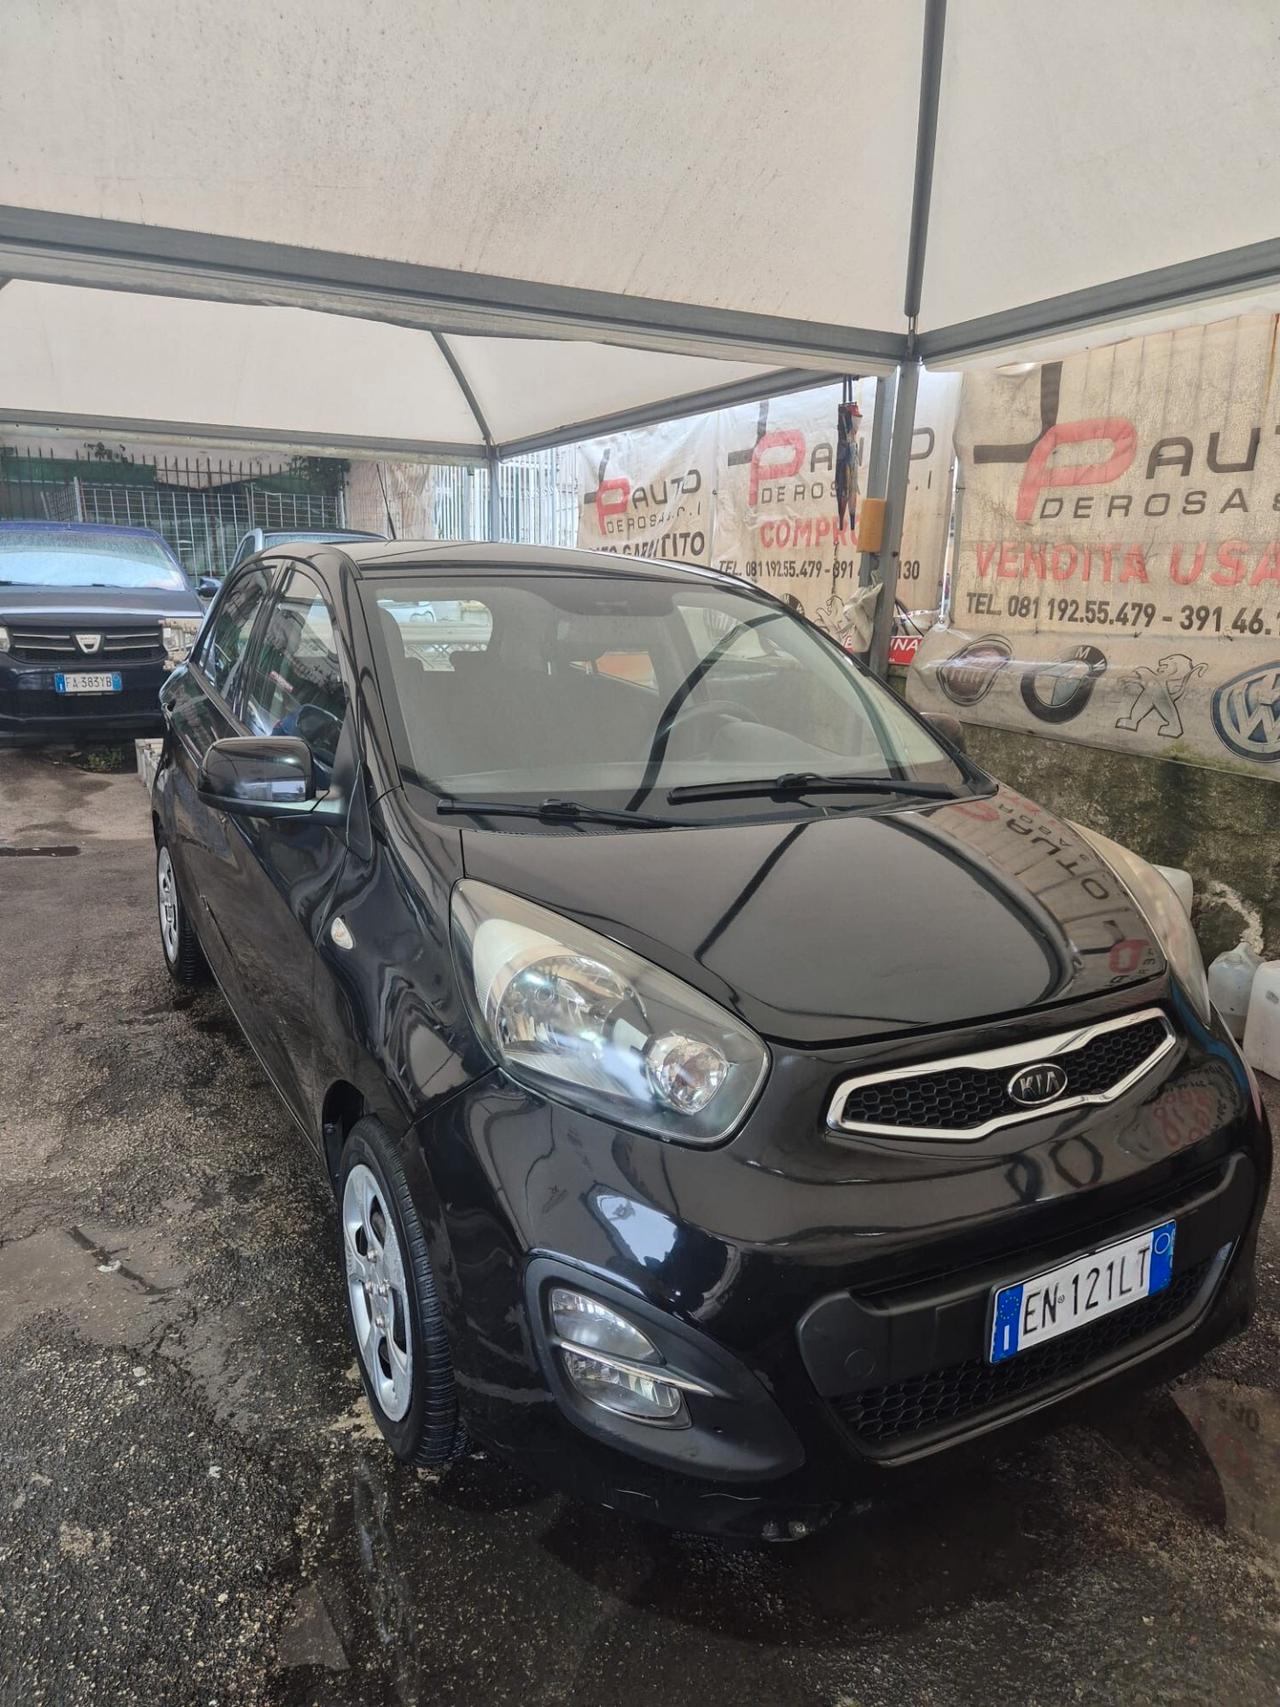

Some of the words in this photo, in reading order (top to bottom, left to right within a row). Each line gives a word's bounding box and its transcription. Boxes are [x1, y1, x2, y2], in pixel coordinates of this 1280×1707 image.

[1039, 487, 1249, 519] DEROSA
[976, 542, 1150, 584] VENDITA
[1007, 595, 1040, 619] 081
[1047, 598, 1157, 627] 192.55.479
[1179, 604, 1223, 632] 391
[1020, 1071, 1060, 1099] KIA
